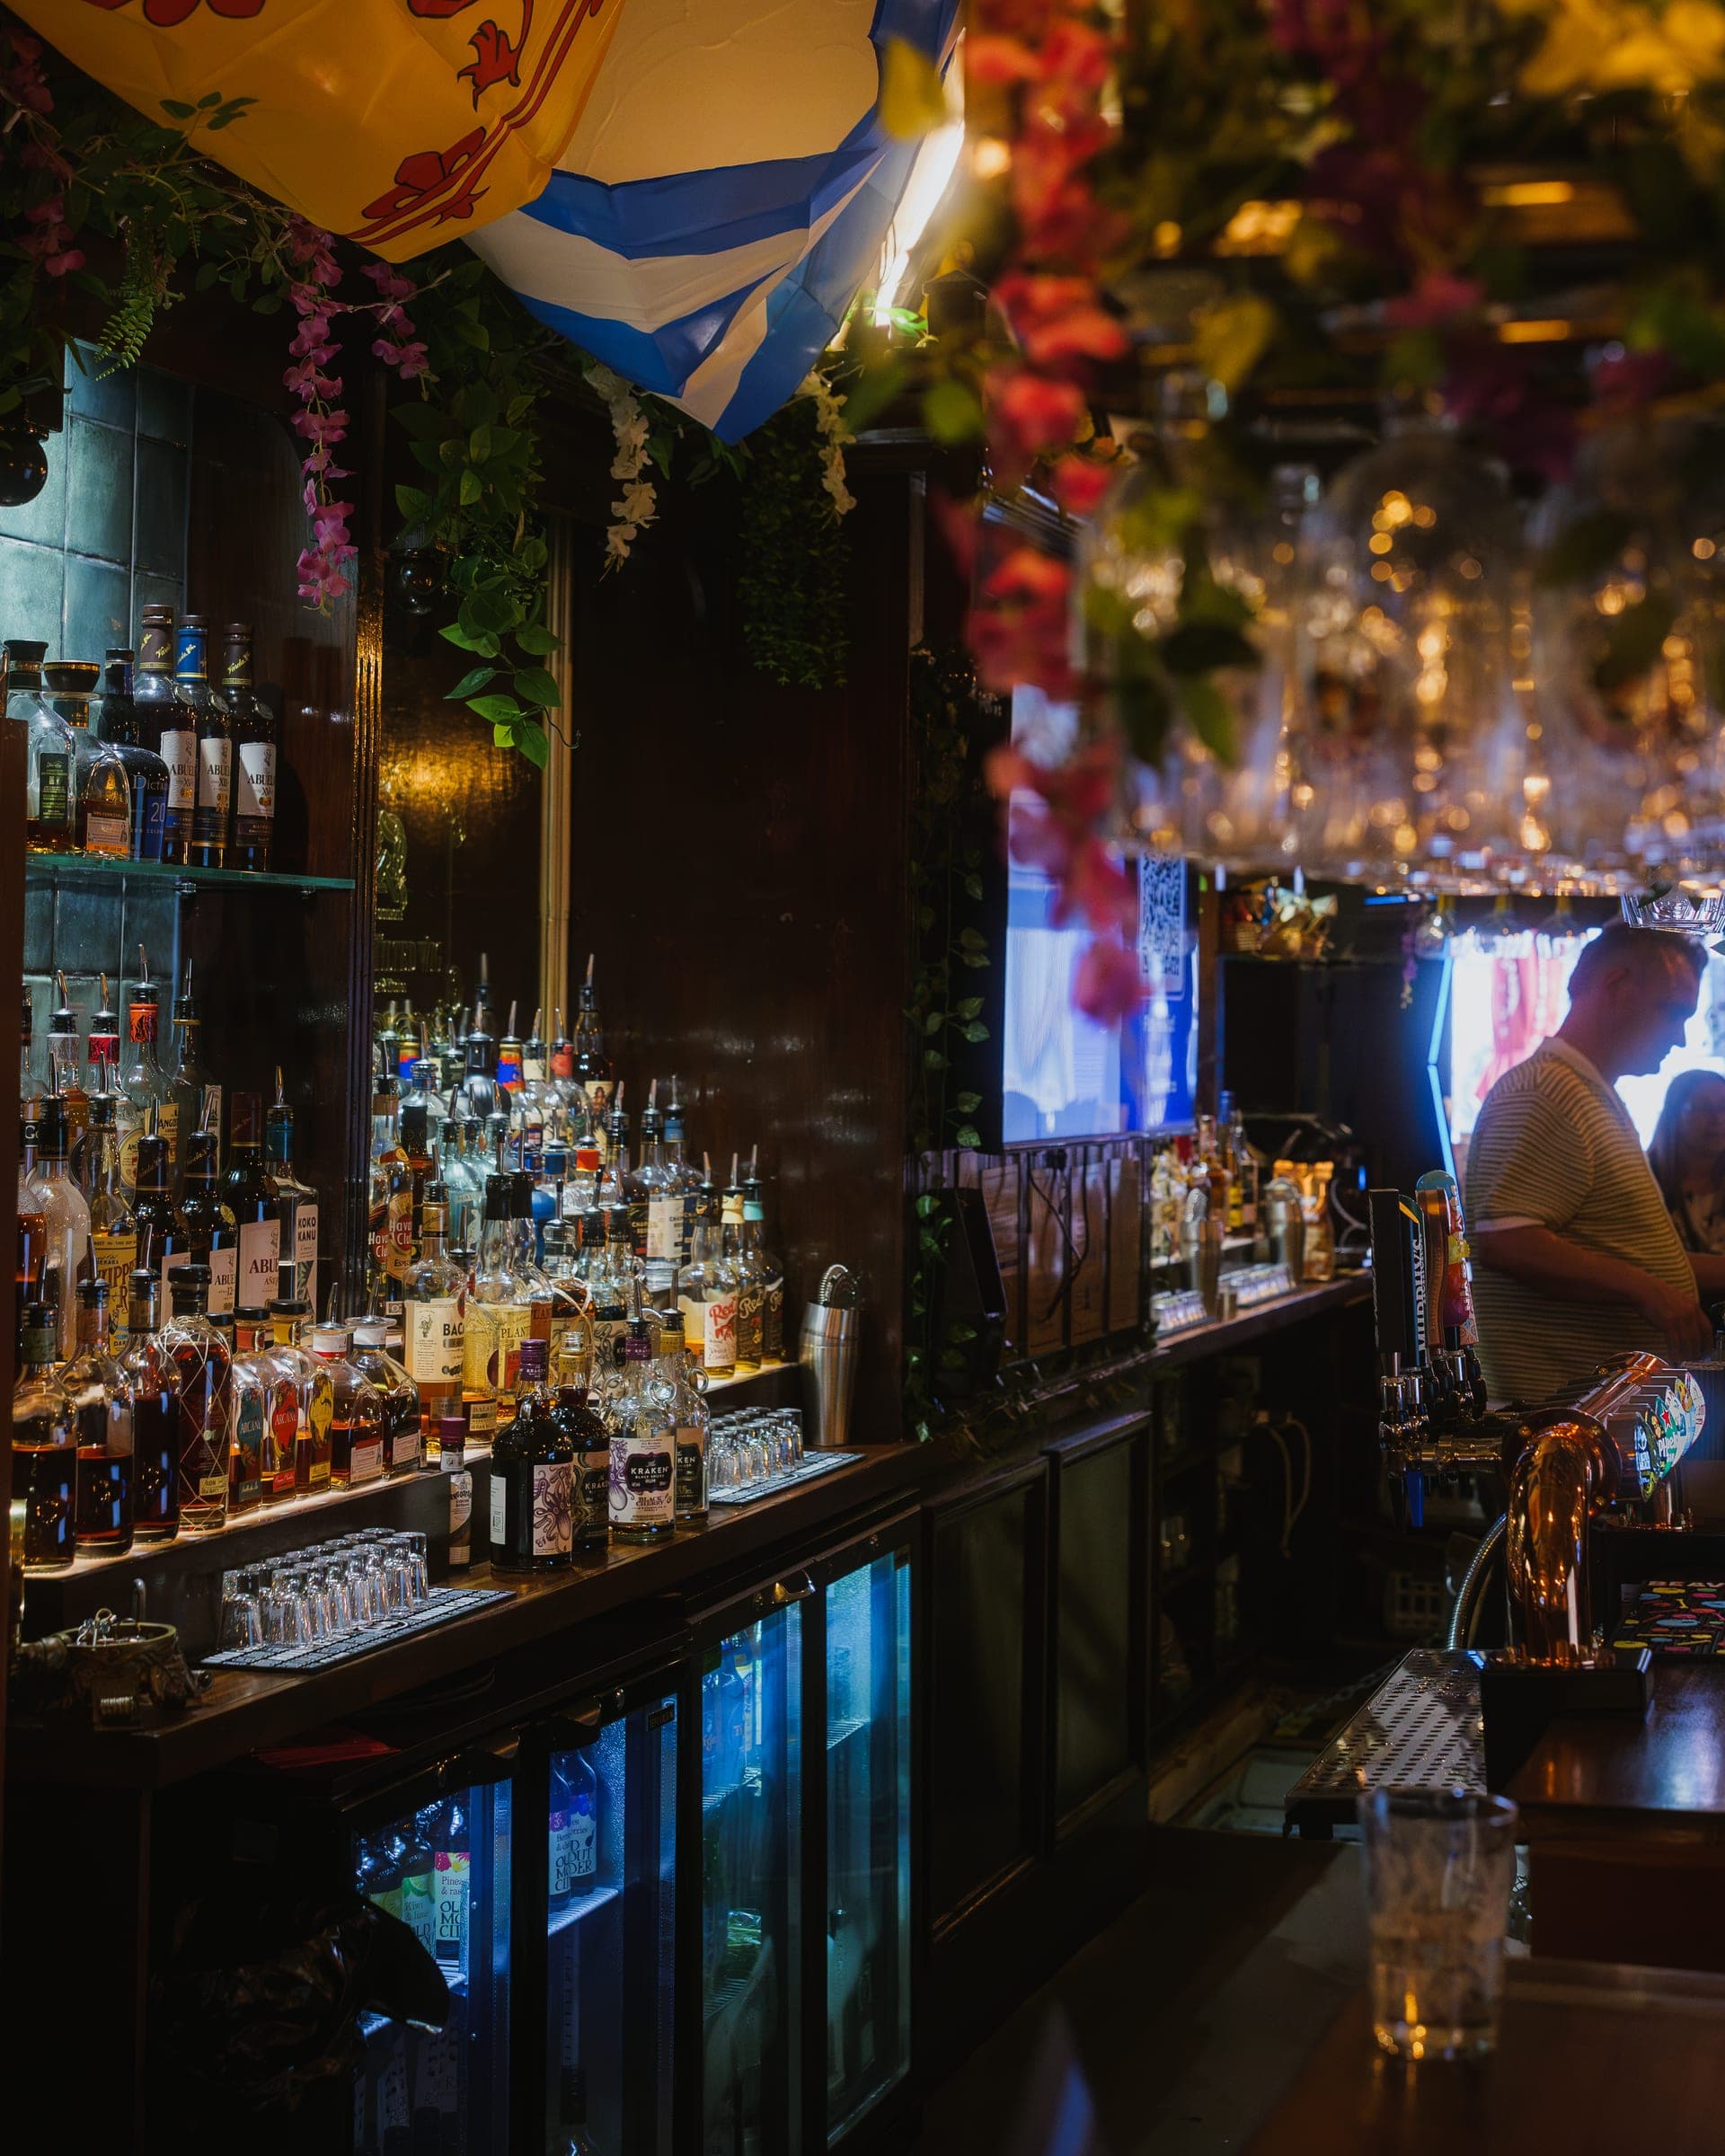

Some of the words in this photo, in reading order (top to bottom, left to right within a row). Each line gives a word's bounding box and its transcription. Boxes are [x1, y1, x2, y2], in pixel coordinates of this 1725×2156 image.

[151, 802, 165, 823] 20
[298, 1217, 316, 1229] KOKO
[298, 1230, 316, 1241] KANU
[710, 1296, 738, 1326] Red
[739, 1290, 763, 1319] Red
[631, 1466, 668, 1475] KRAKEN
[569, 1847, 593, 1862] OUT
[569, 1860, 592, 1875] DER
[416, 1923, 431, 1937] LD
